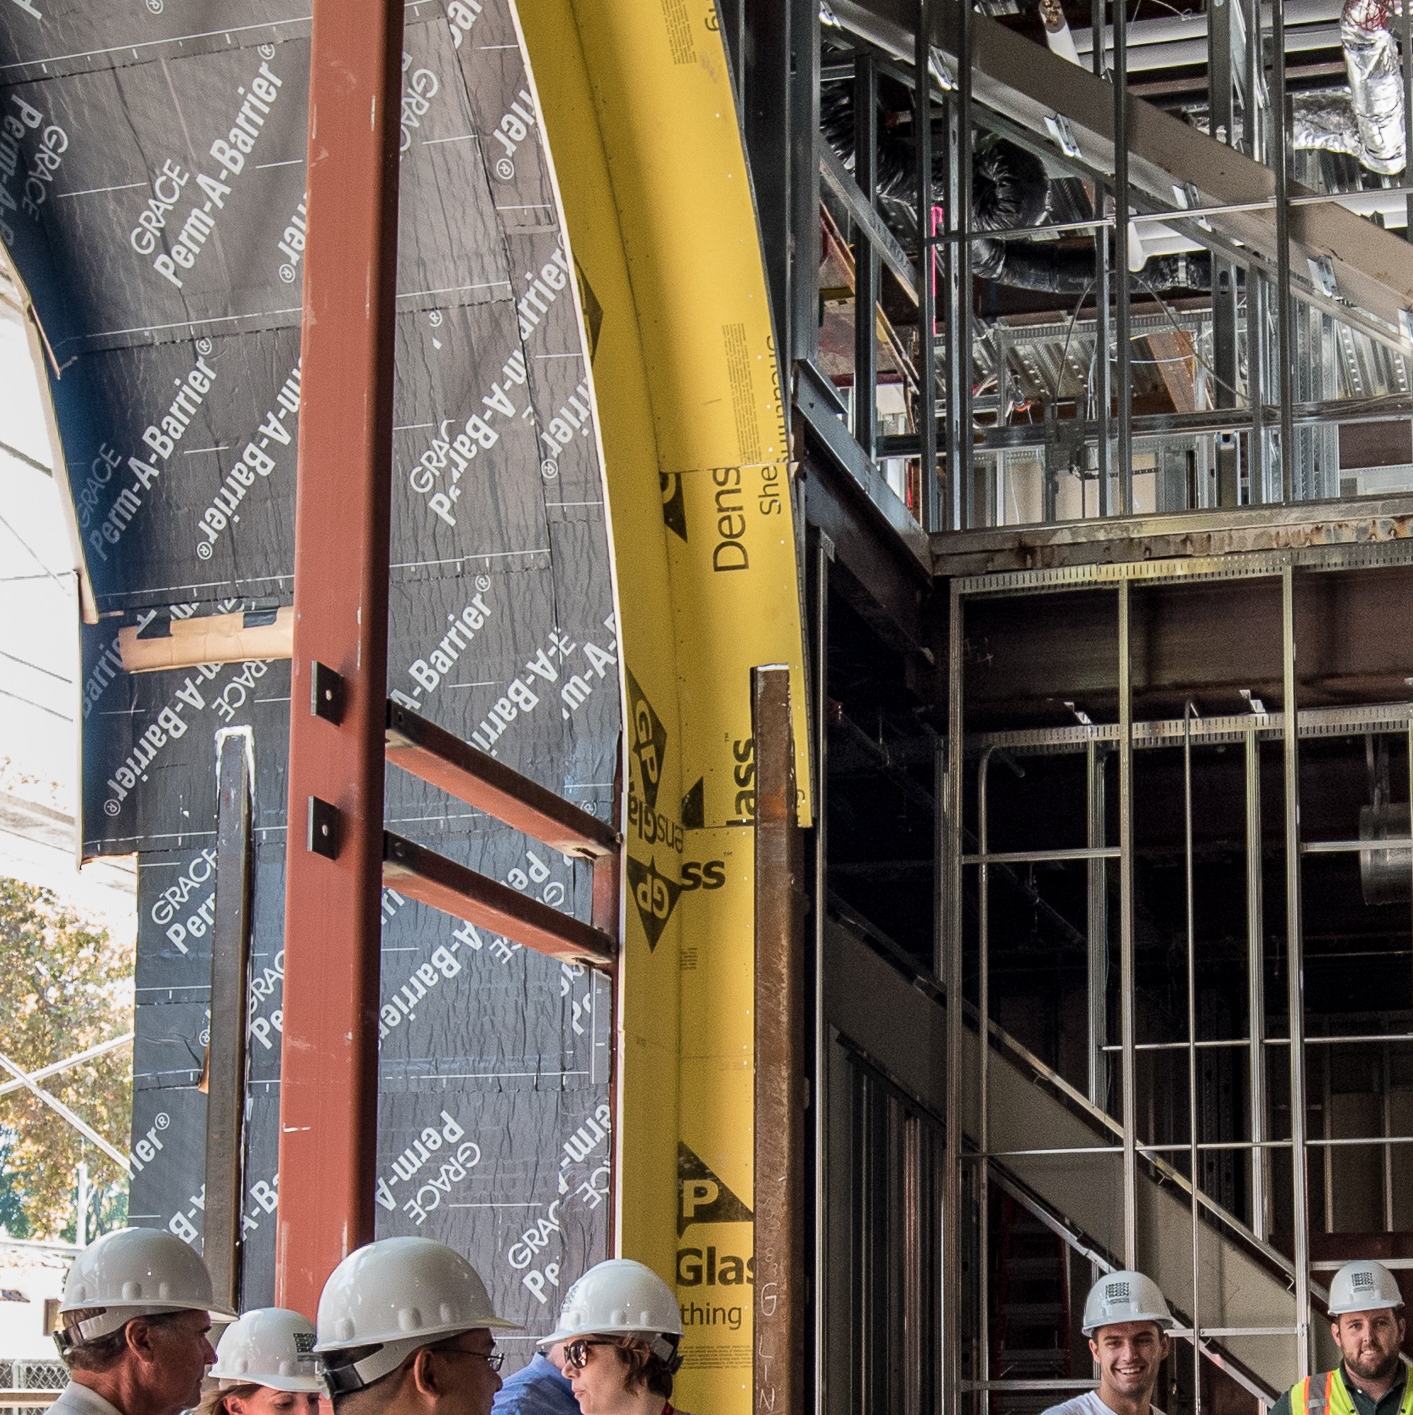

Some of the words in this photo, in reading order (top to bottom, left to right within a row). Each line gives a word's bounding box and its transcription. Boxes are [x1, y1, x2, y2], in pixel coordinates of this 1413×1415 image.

[130, 159, 190, 255] GRACE
[712, 467, 750, 572] Dens
[636, 699, 658, 785] GP
[637, 875, 669, 920] GP
[403, 1142, 482, 1226] GRACE
[680, 1302, 743, 1331] thing
